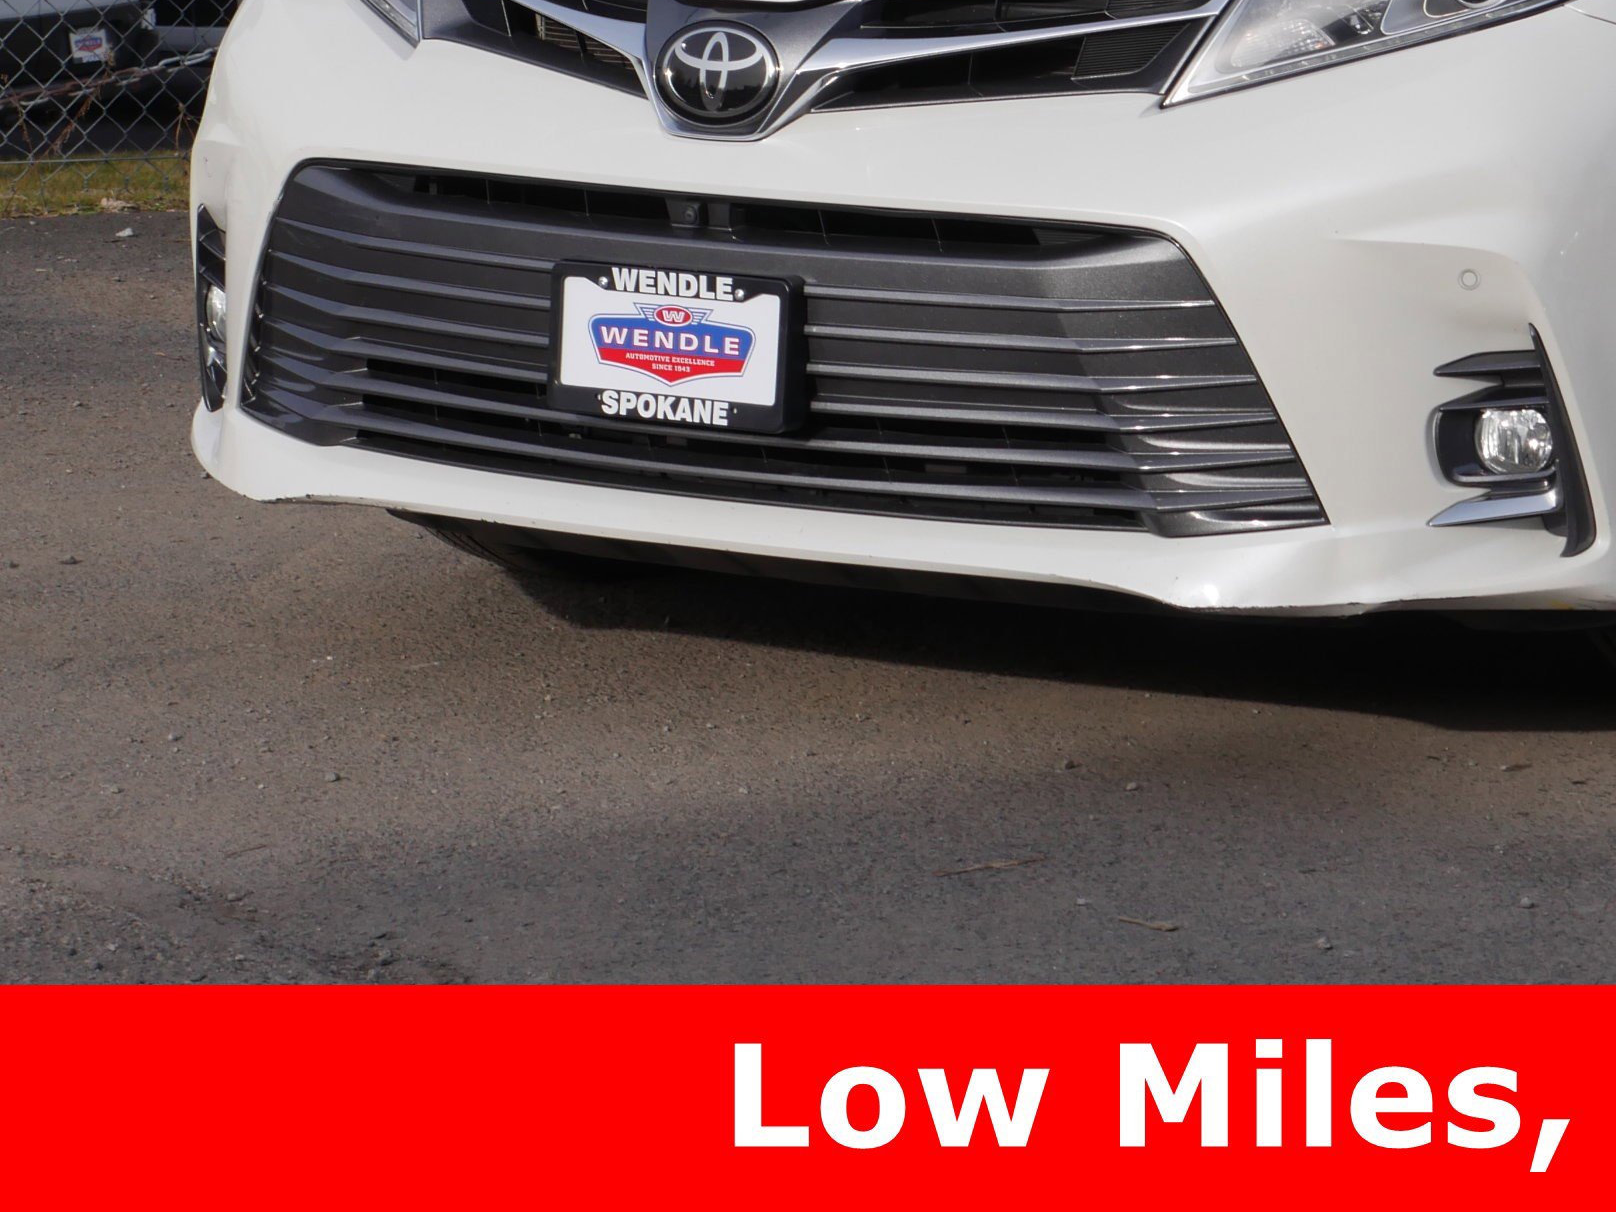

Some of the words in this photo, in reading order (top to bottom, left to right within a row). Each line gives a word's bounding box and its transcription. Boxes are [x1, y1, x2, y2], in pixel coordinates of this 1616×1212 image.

[611, 267, 734, 302] WENDLE
[600, 325, 740, 356] WENDLE
[625, 352, 671, 363] AUTOMOTIVE
[671, 356, 716, 368] EXCELLENCE
[651, 363, 673, 371] SINCE
[674, 365, 691, 373] 1943
[601, 390, 729, 427] SPOKANE
